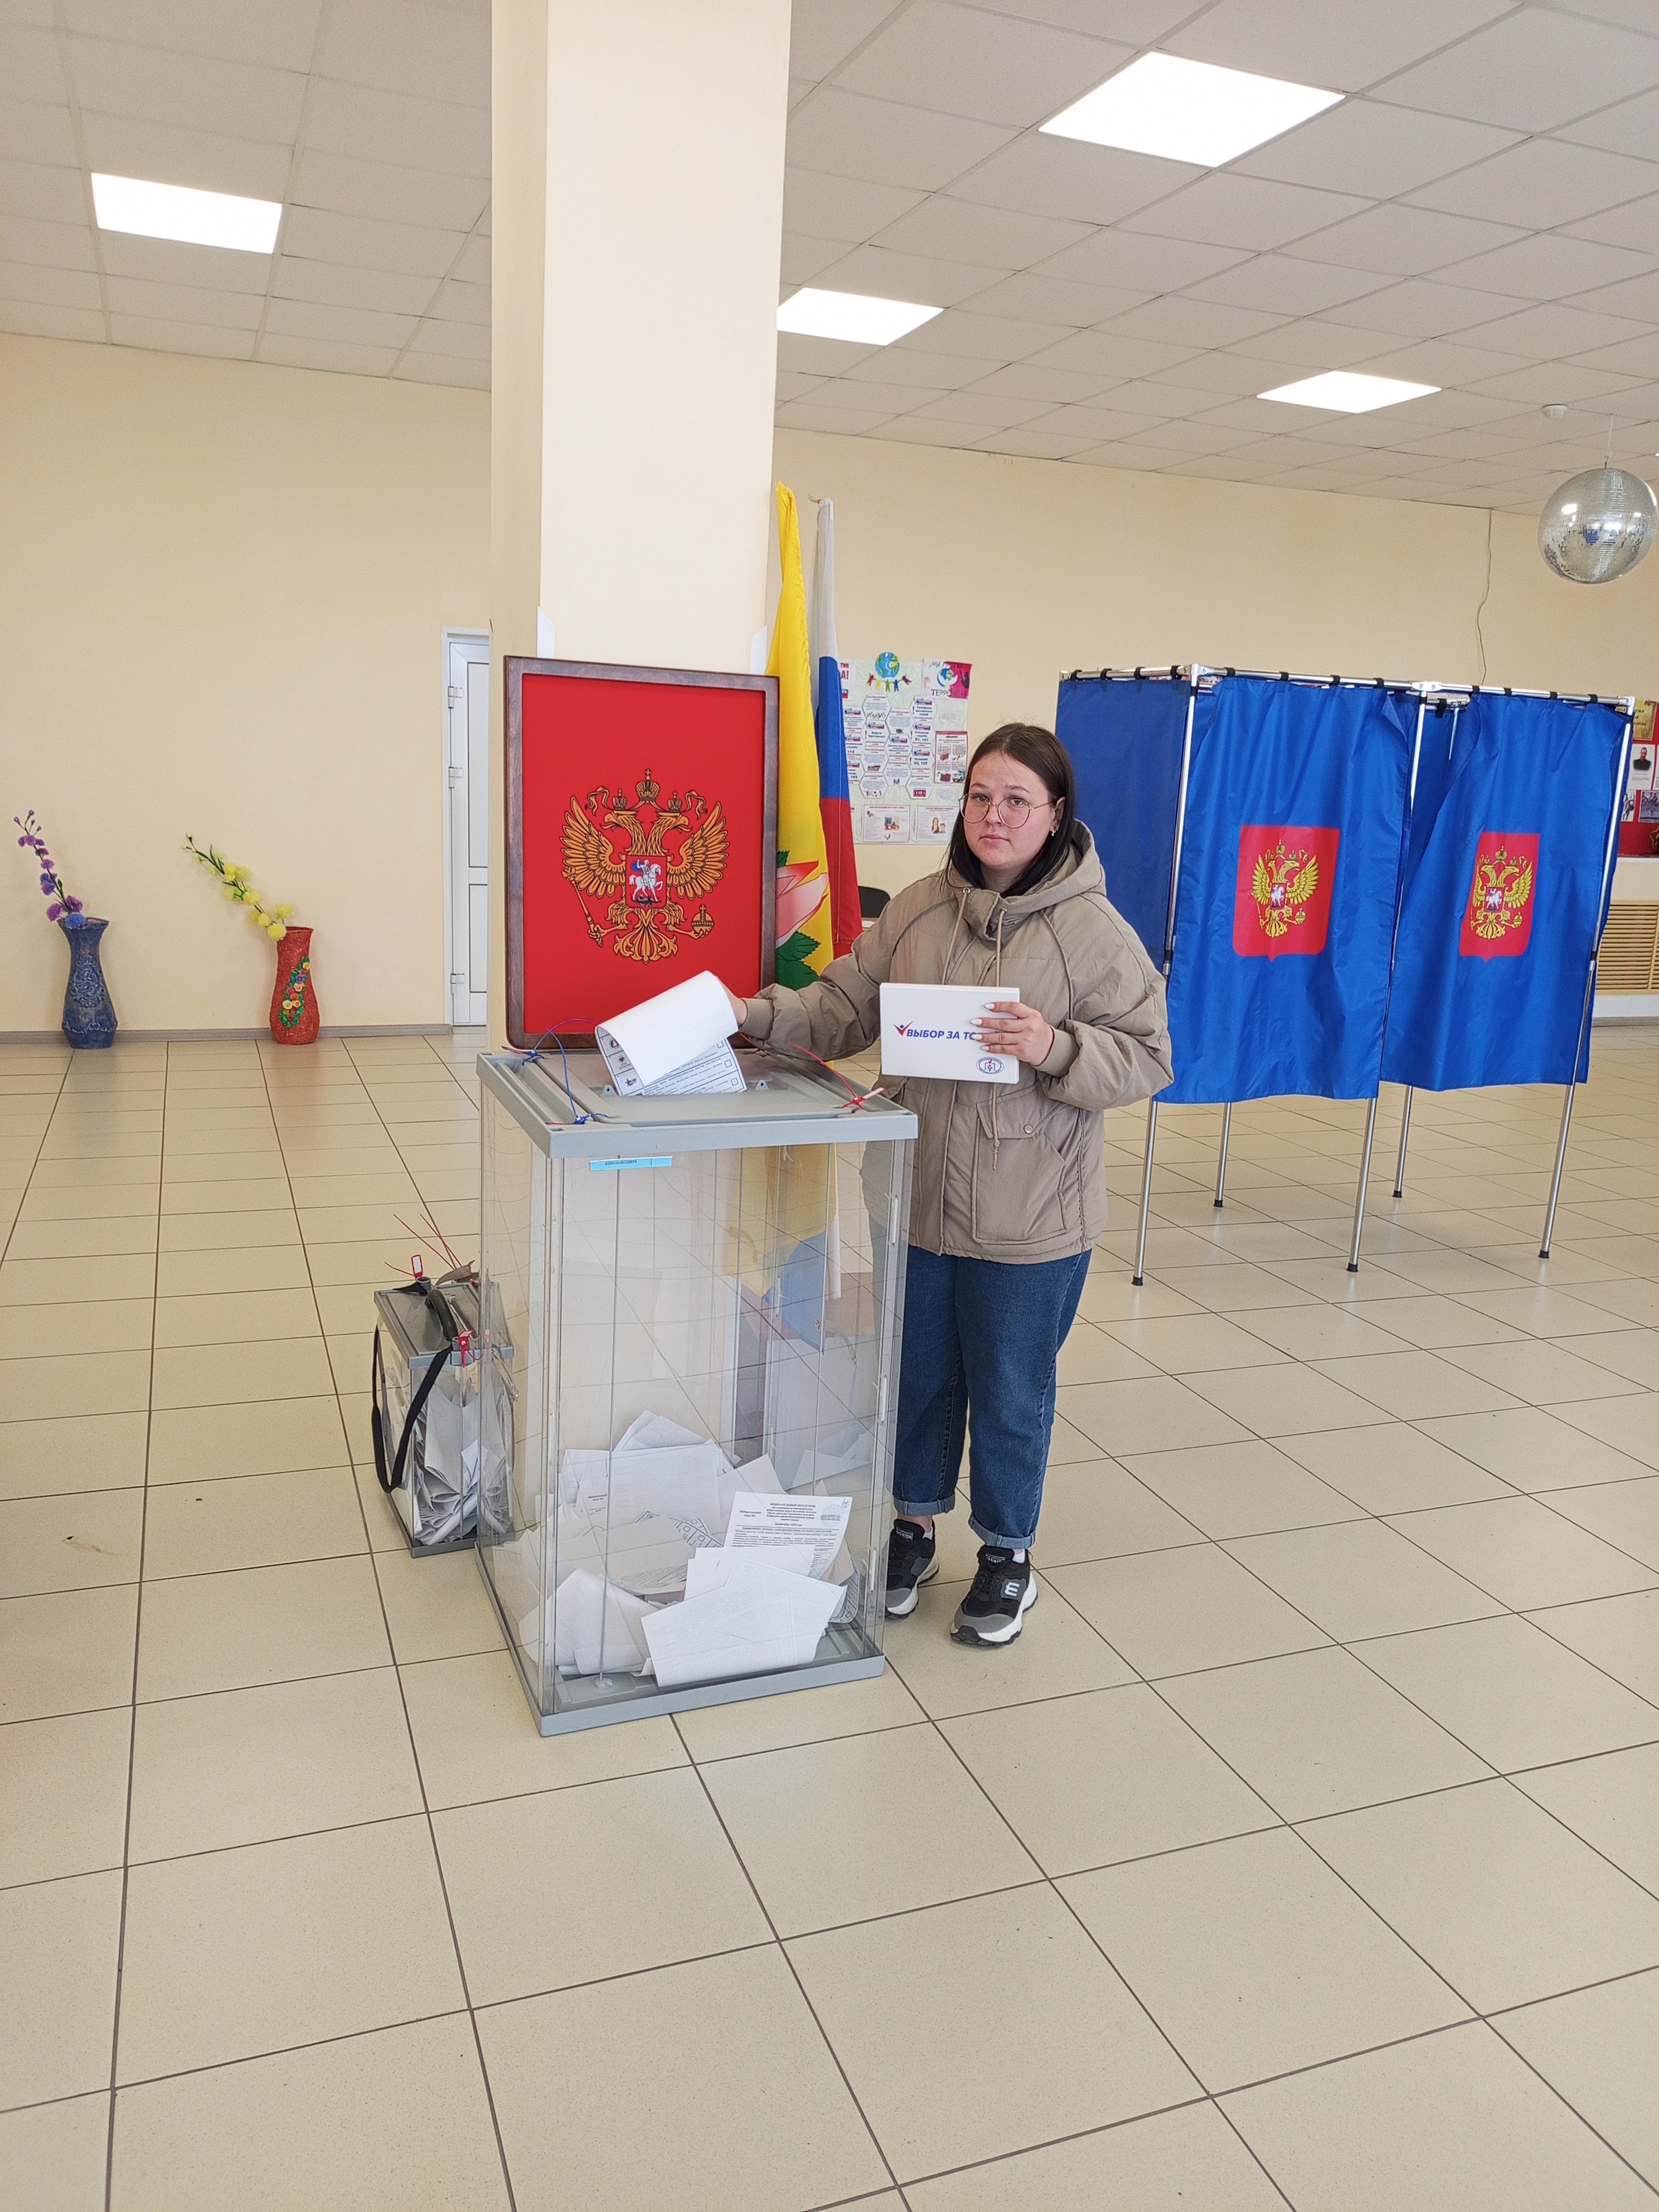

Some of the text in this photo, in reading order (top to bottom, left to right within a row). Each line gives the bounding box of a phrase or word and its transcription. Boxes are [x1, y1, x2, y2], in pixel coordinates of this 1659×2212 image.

[906, 1029, 944, 1039] ВЫБОР
[946, 1031, 960, 1040] ЗА
[896, 1530, 912, 1540] FASHION
